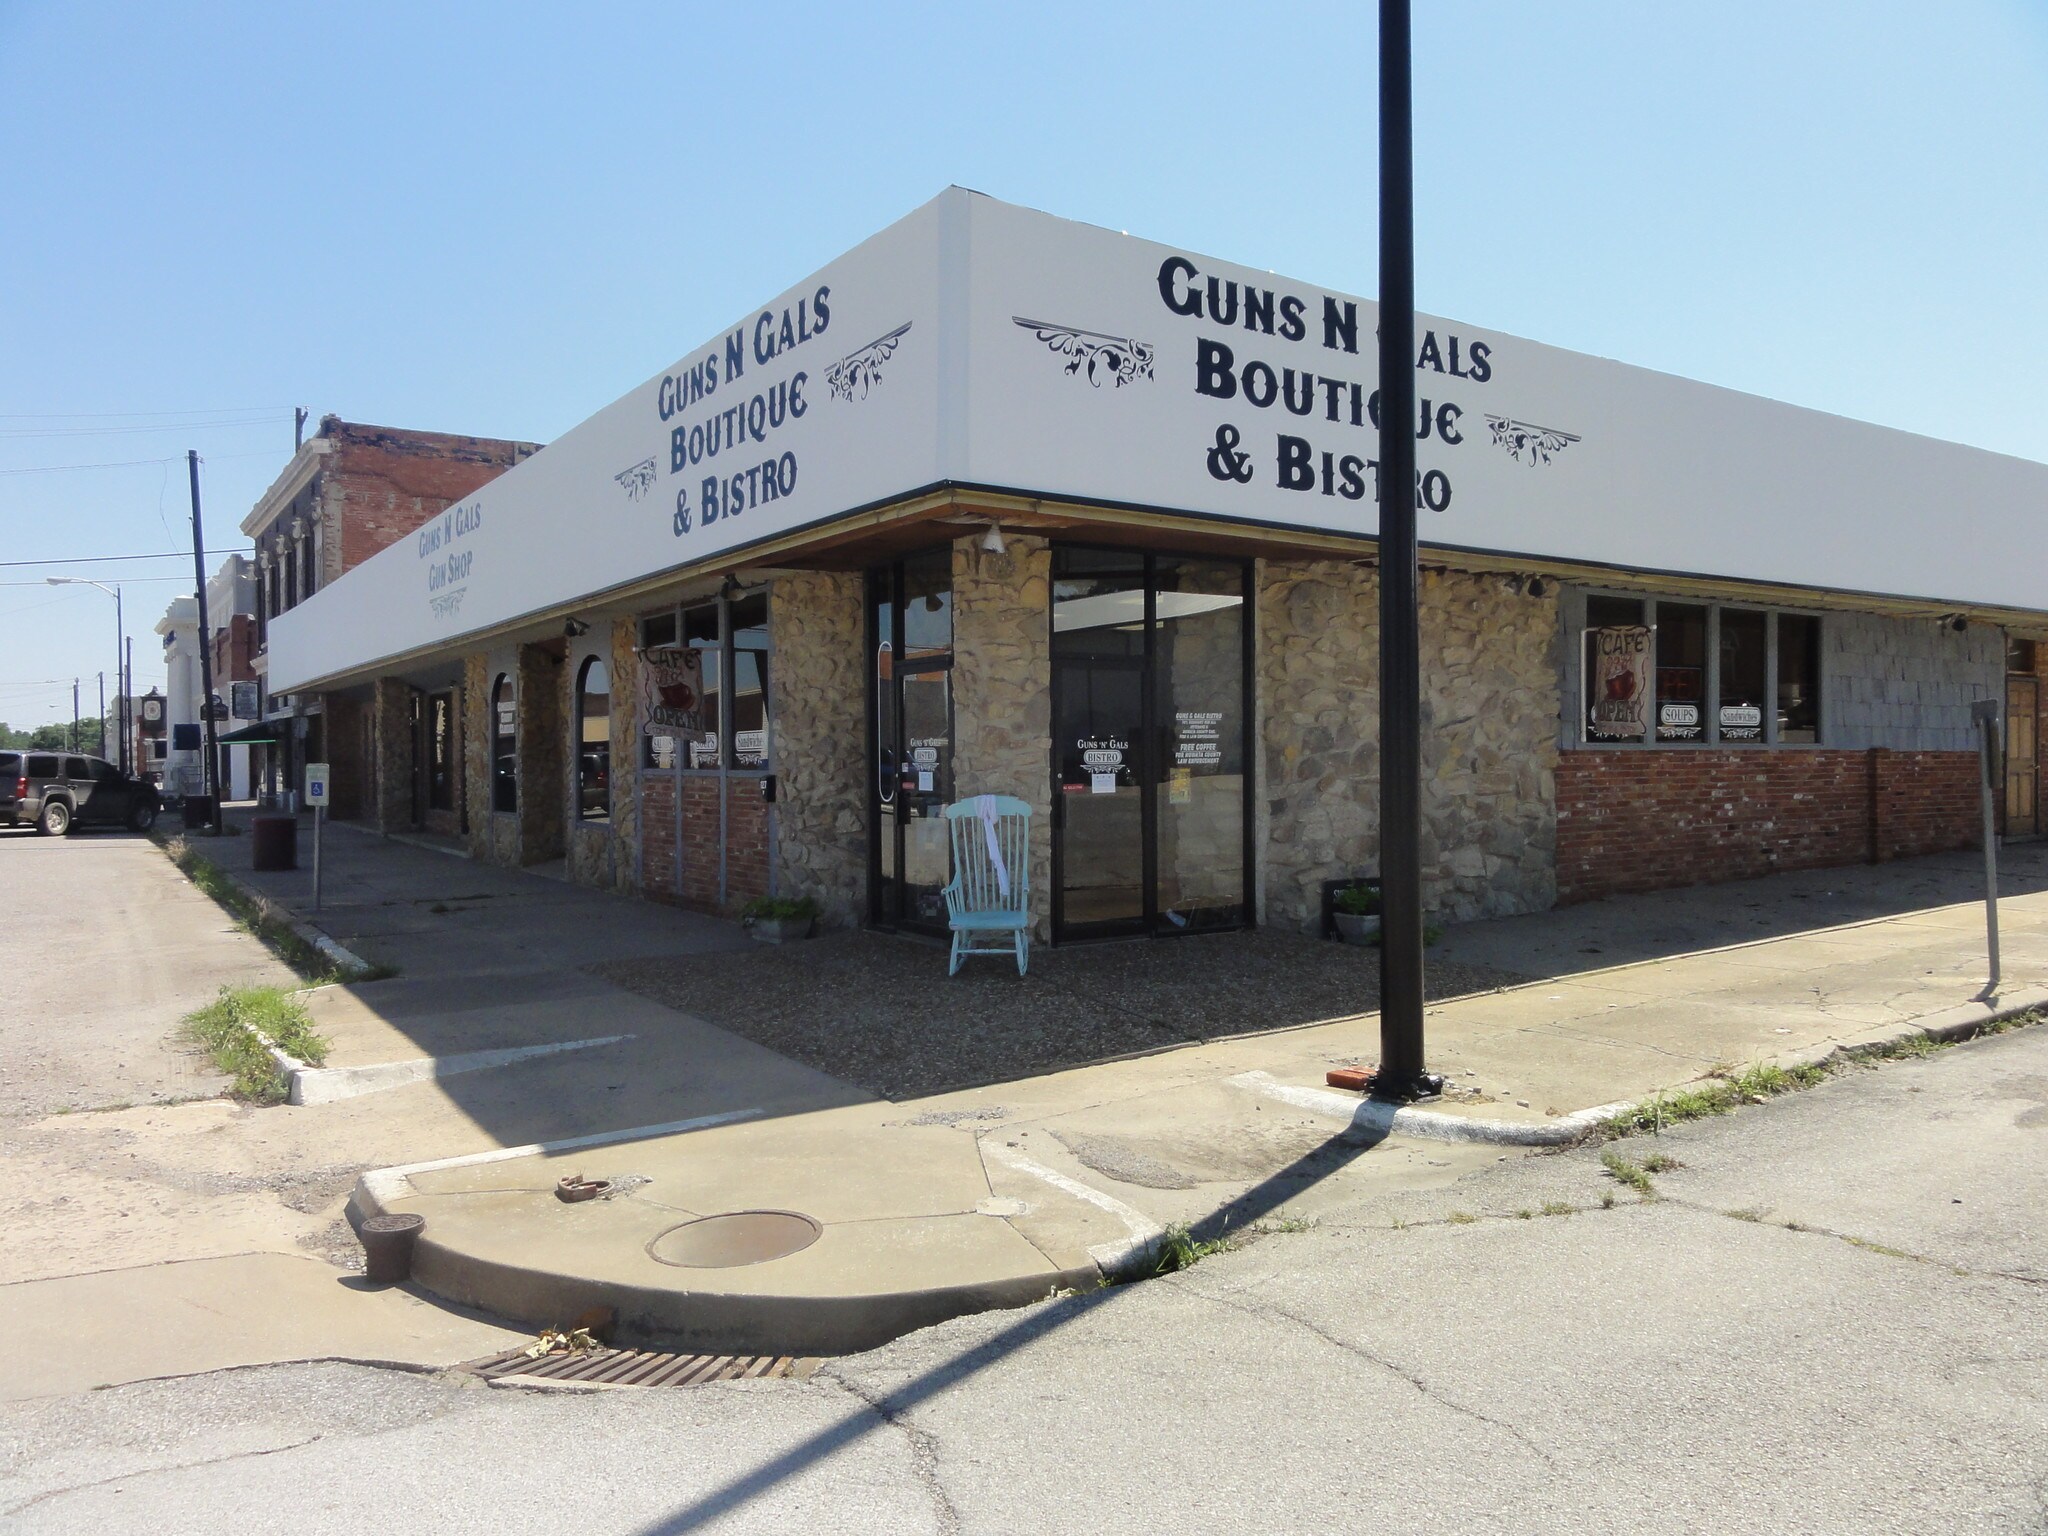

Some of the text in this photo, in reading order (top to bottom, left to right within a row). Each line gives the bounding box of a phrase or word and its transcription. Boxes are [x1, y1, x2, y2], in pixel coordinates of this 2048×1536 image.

[1157, 256, 1492, 383] GUNS N ALS
[658, 286, 831, 421] GUNS N GALS
[670, 371, 809, 475] BOUTIQUE
[1206, 423, 1254, 484] &
[673, 451, 798, 537] & BISTRO
[419, 502, 481, 559] GUNS N GALS
[428, 550, 473, 592] GUN SHOP
[1665, 708, 1694, 721] SOUPS
[1077, 739, 1098, 749] GUNS
[1110, 739, 1129, 749] GALS
[1088, 753, 1118, 762] BISTRO
[1180, 743, 1217, 751] FREE COFFEE
